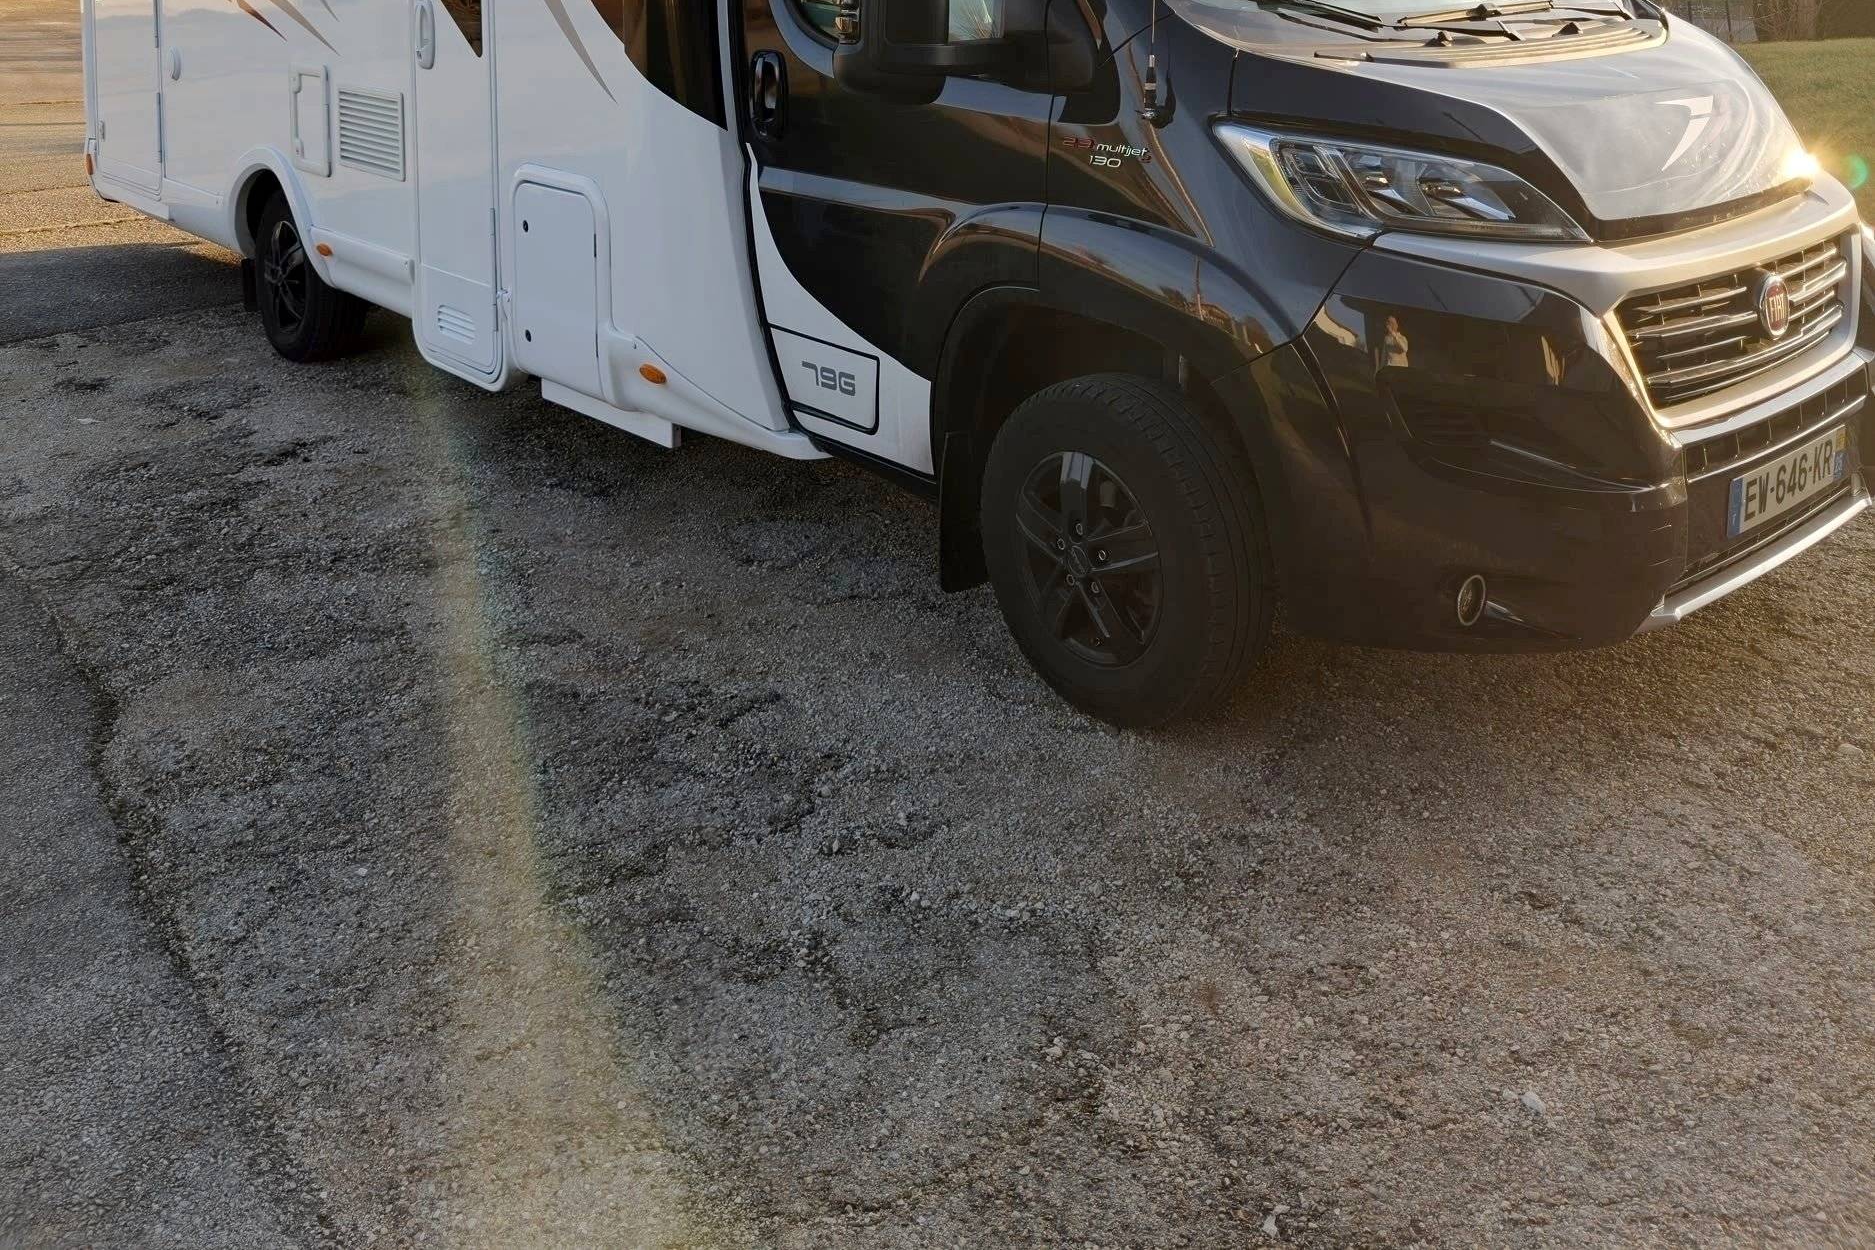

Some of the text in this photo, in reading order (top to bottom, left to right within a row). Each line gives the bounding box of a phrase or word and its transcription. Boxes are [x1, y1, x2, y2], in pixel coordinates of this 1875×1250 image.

[1096, 143, 1148, 157] multijet
[1089, 155, 1121, 168] 130
[1743, 438, 1833, 522] EW-646-KR
